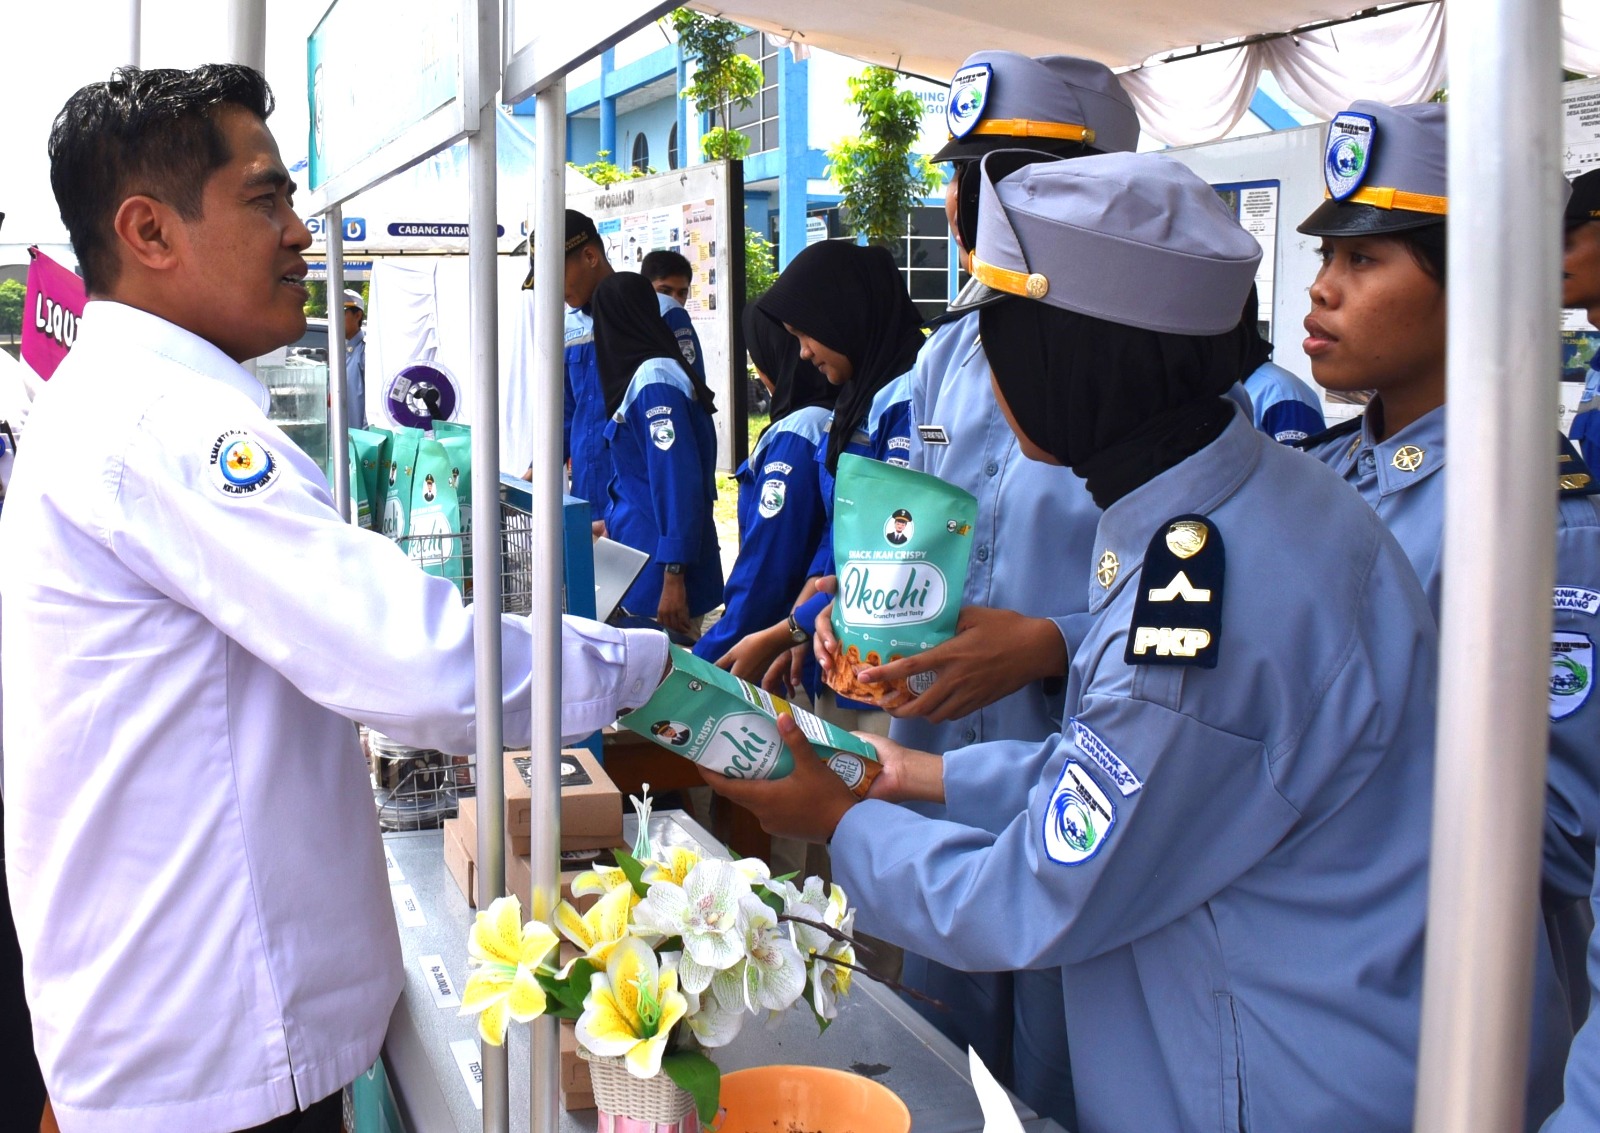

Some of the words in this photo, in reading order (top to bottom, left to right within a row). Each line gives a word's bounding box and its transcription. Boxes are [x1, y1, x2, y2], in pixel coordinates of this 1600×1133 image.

[594, 189, 635, 211] INFORMASI
[398, 225, 439, 236] CABANG
[36, 291, 83, 348] LIQU
[849, 550, 872, 560] SNACK
[895, 551, 927, 560] CRISPY
[844, 567, 931, 615] Okochi
[1581, 592, 1598, 602] KP
[1134, 626, 1211, 657] PKP
[695, 715, 716, 745] CRISPY
[1078, 723, 1122, 769] POLITEKNIK
[1121, 770, 1136, 785] KP
[1080, 738, 1126, 786] KARAWANG
[834, 758, 848, 778] EST
[843, 761, 859, 783] PRICE
